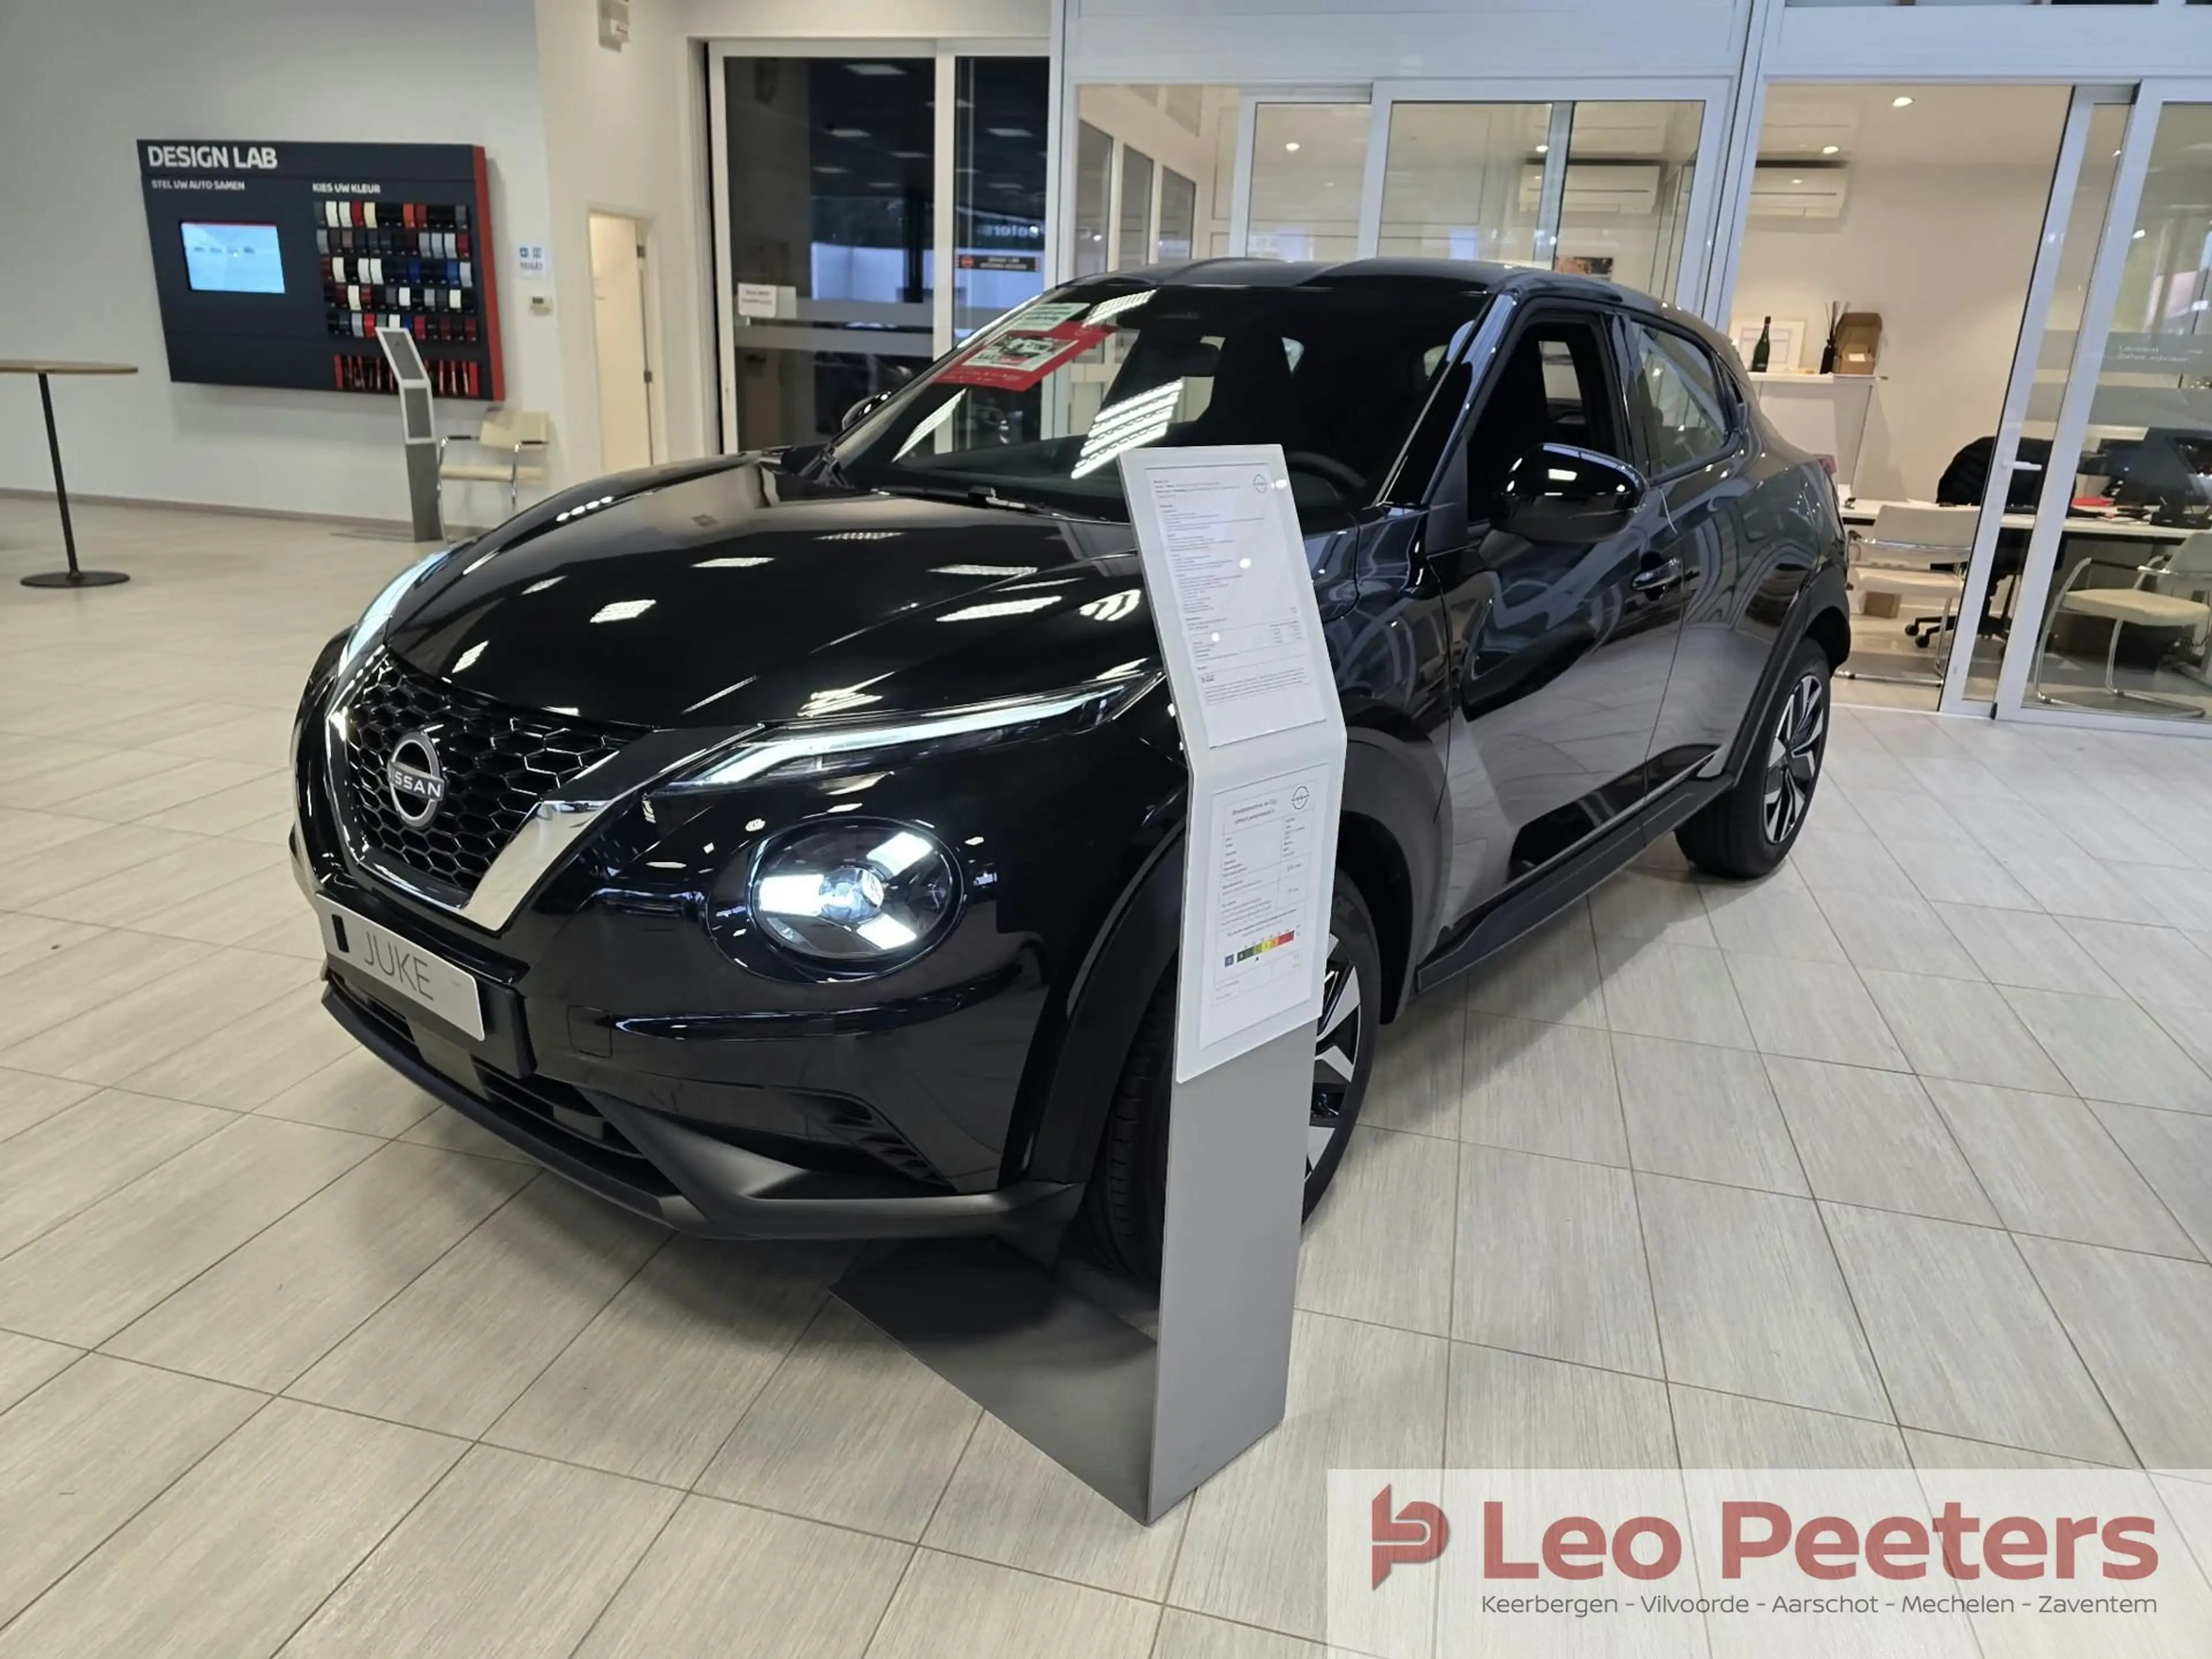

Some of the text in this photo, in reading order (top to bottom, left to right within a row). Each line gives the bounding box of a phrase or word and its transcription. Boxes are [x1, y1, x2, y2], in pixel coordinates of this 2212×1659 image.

[147, 146, 278, 169] DESIGN LAB
[151, 180, 245, 191] STEL UW AUTO SAMEN
[312, 182, 380, 194] KIES UW KLEUR
[365, 931, 434, 1001] JUKE
